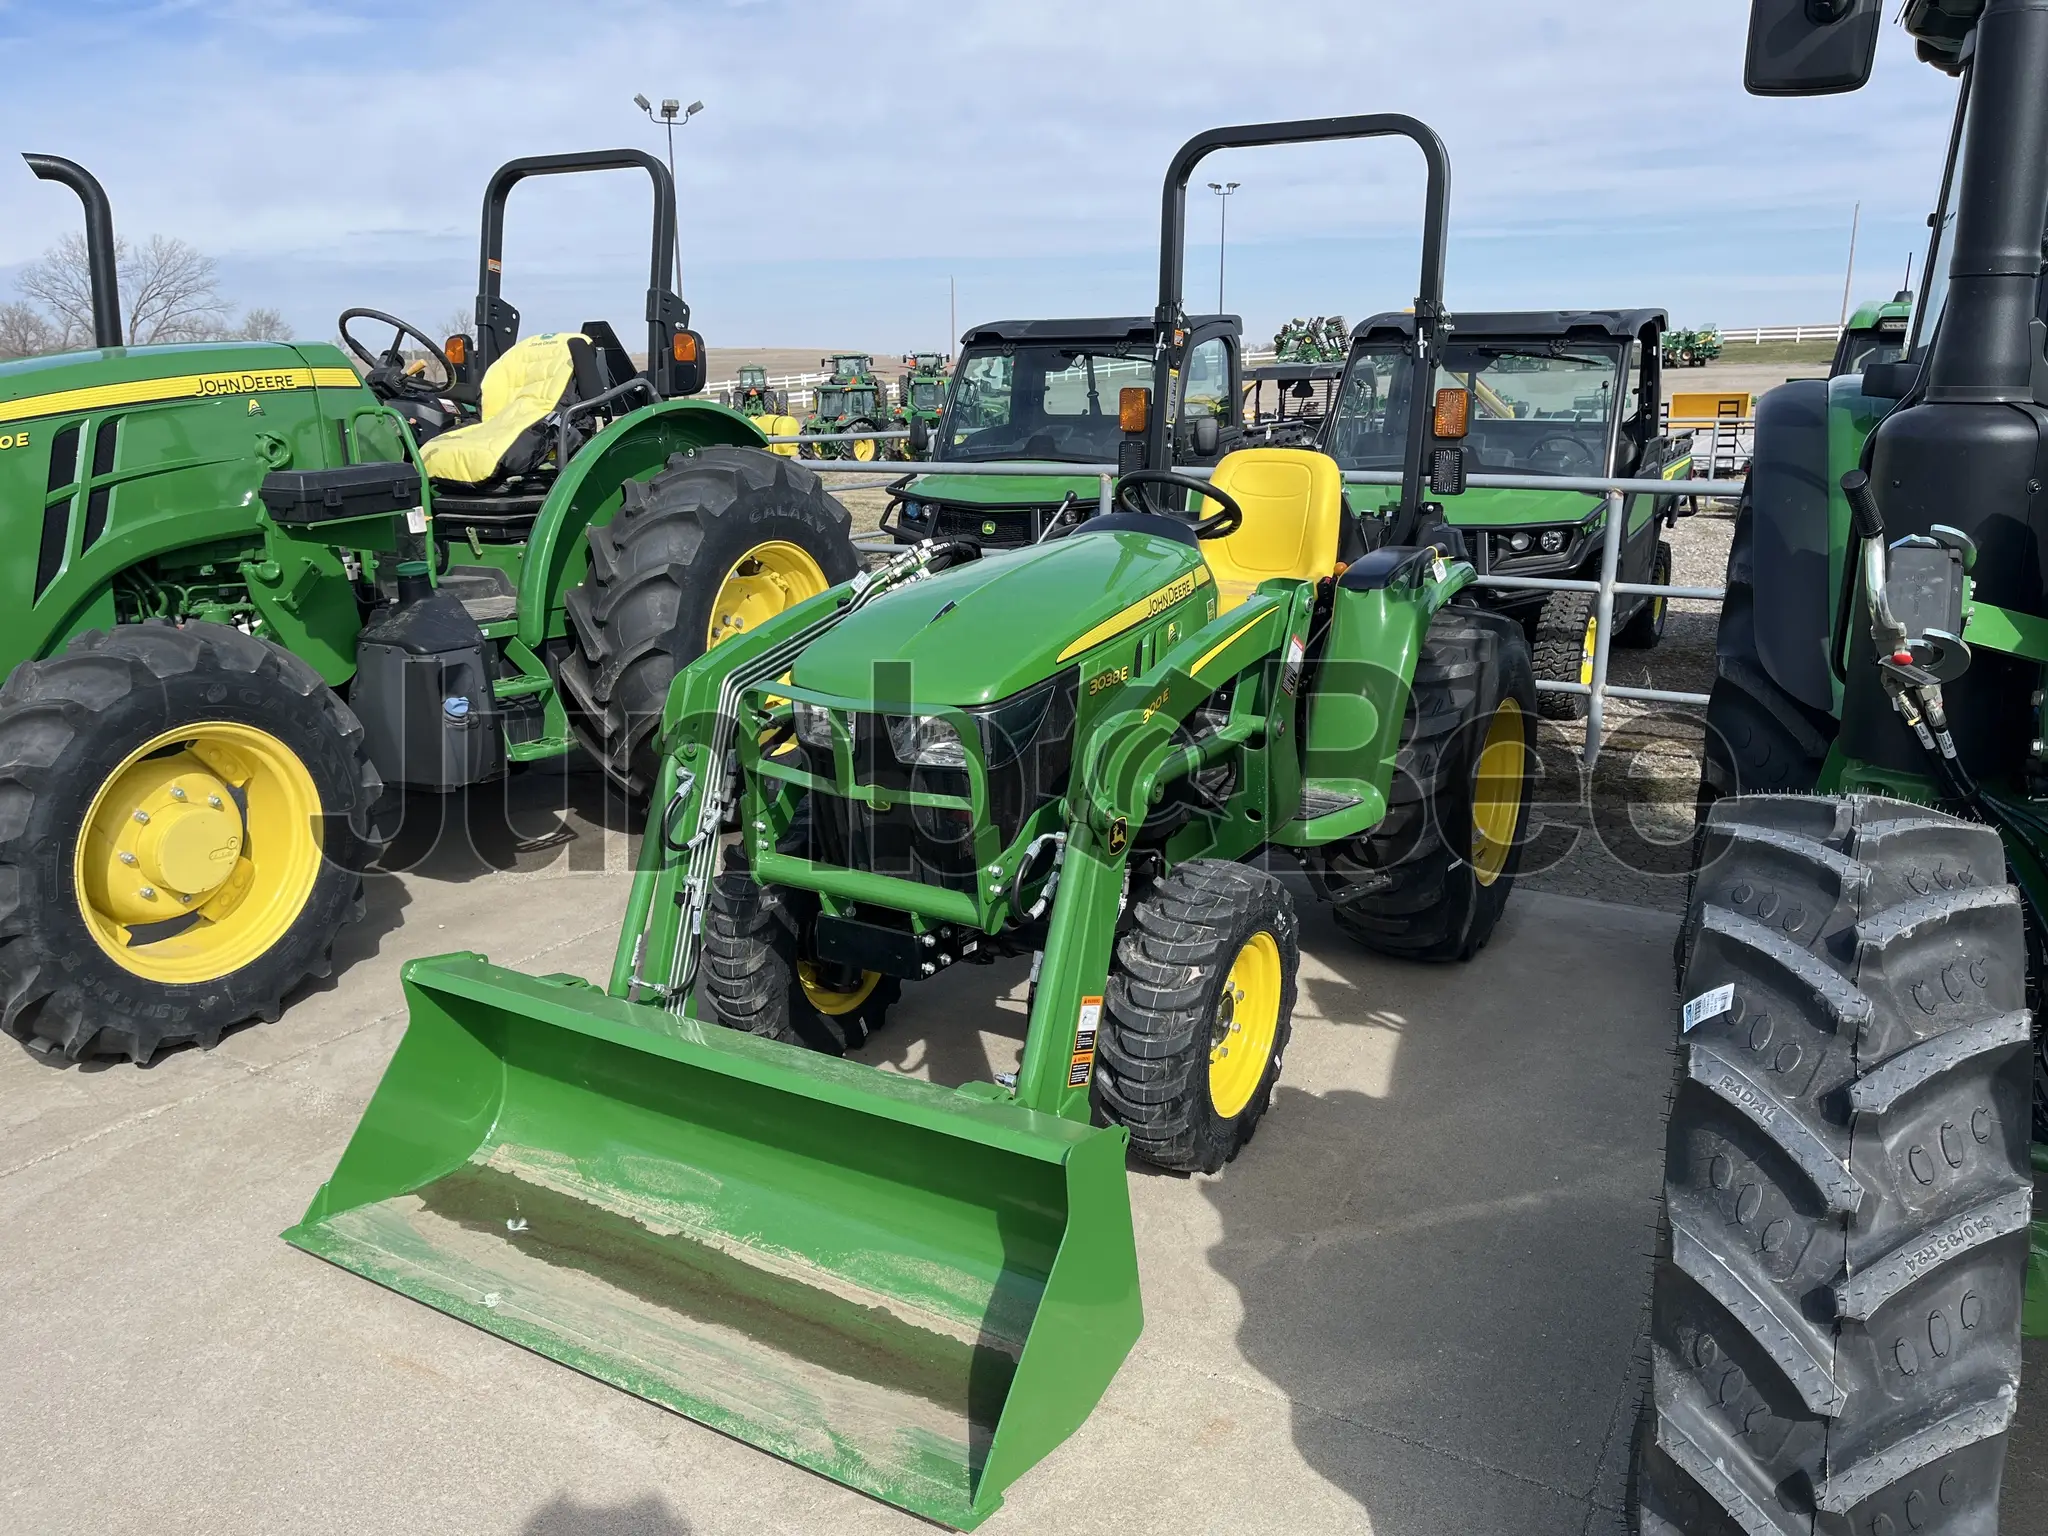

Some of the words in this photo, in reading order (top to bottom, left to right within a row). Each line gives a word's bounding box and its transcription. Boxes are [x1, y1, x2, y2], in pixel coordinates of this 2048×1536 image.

[195, 378, 240, 394] JOHN
[241, 375, 296, 392] DEERE
[749, 505, 827, 534] GALAXY
[1147, 597, 1169, 617] JOHN
[1168, 580, 1191, 604] DEERE
[1089, 665, 1129, 696] 3038E
[1719, 1075, 1775, 1124] RADIAL
